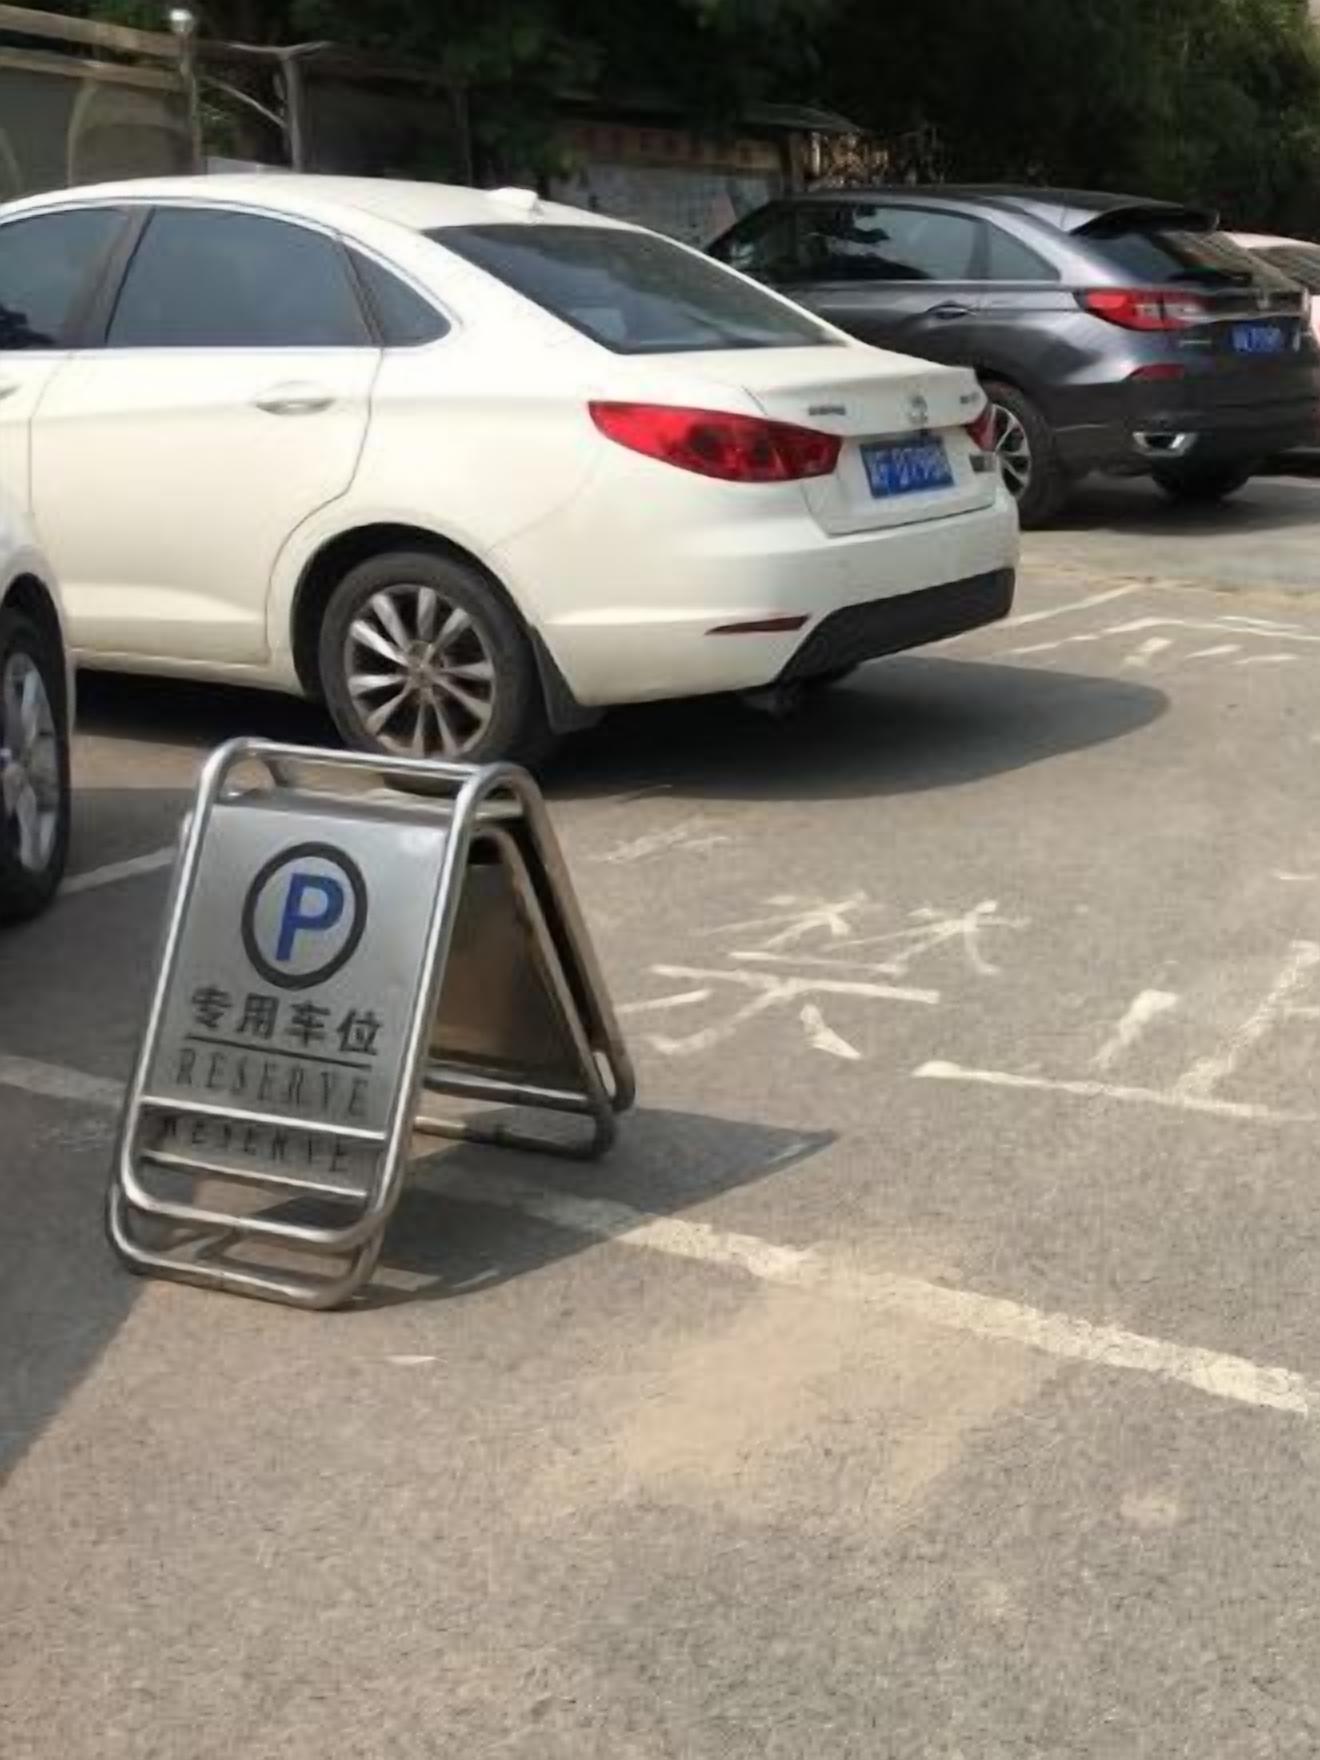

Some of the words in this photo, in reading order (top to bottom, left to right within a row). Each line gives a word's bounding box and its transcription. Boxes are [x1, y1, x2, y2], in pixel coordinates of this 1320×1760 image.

[274, 873, 345, 962] P
[191, 984, 383, 1056] 专用车位
[175, 1047, 369, 1117] RESERVE
